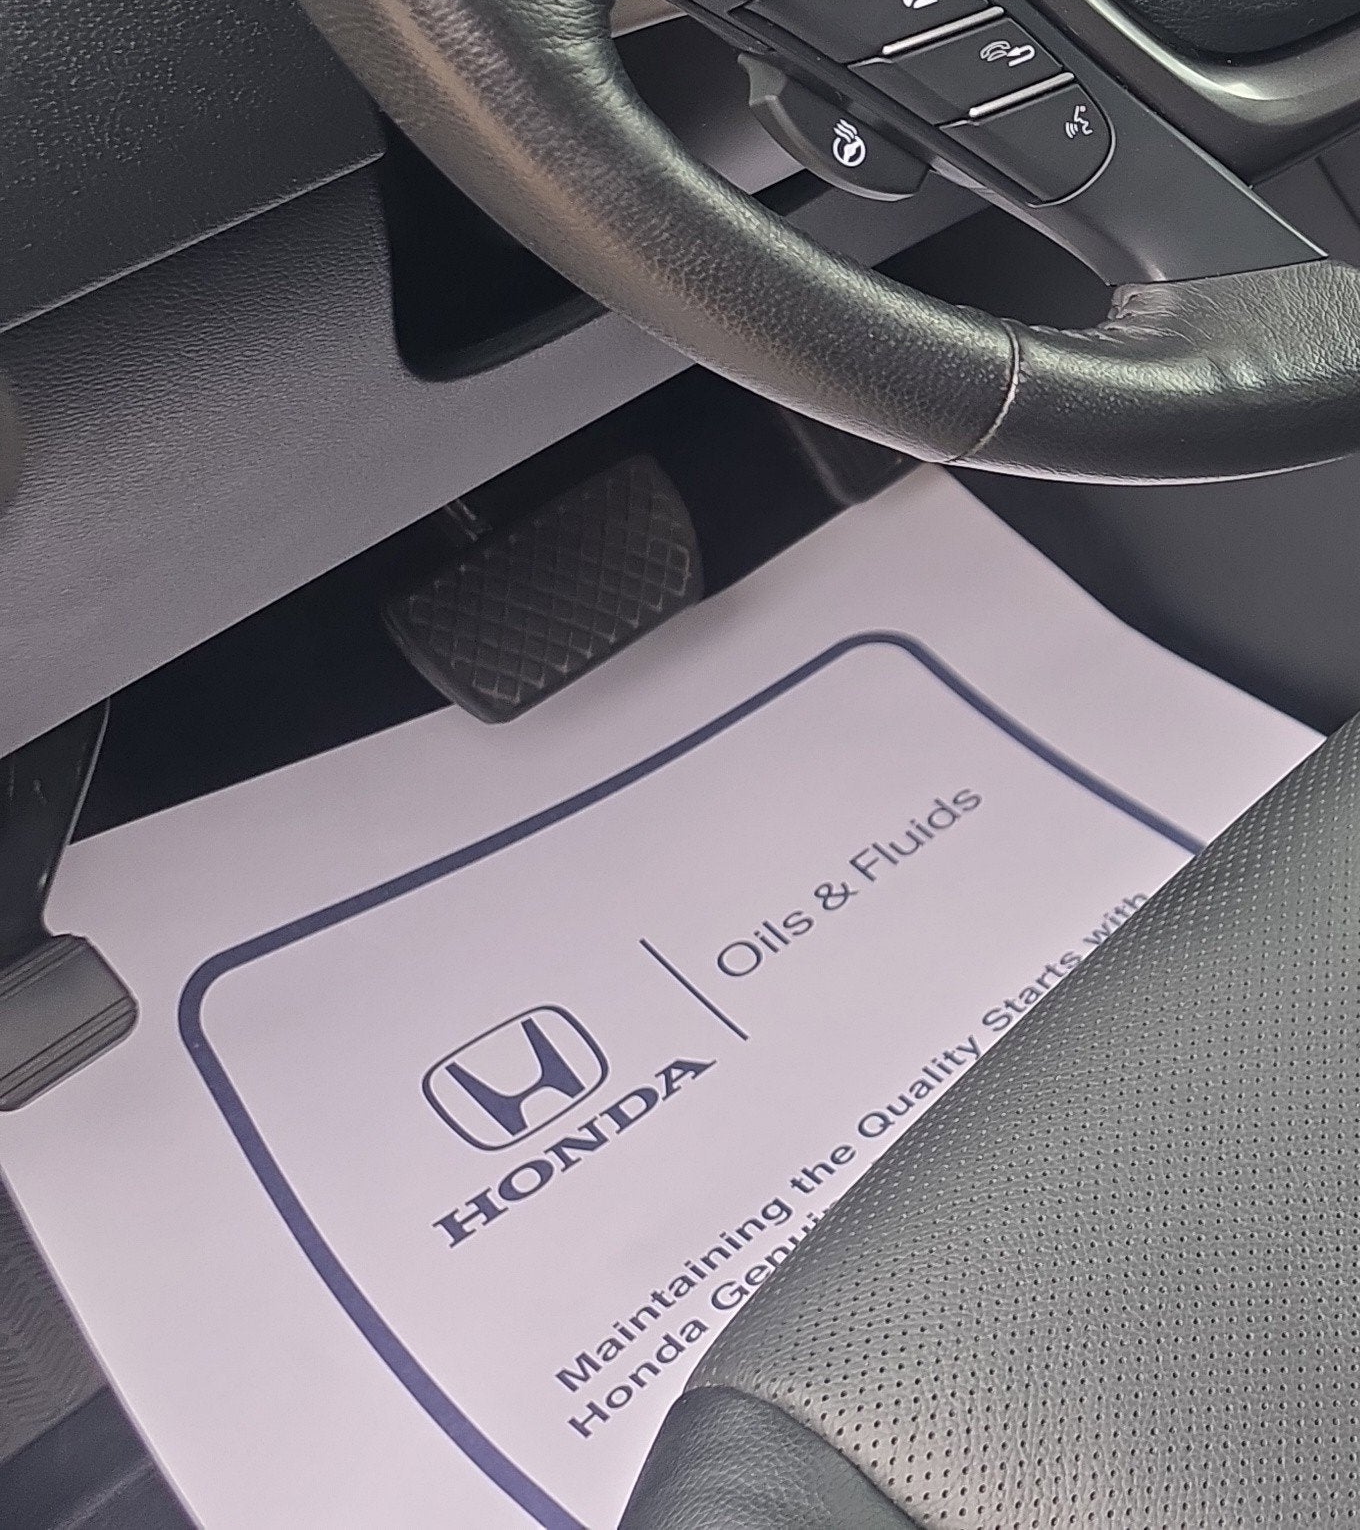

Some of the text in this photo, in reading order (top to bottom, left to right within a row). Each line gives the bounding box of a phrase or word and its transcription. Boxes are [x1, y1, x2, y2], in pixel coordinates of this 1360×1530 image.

[715, 785, 982, 979] Oils & Fluids
[432, 1055, 718, 1249] HONDA
[555, 1197, 794, 1394] Maintaining
[790, 1142, 857, 1194] the
[857, 1033, 982, 1141] Quality
[982, 950, 1083, 1033] Starts
[568, 1318, 709, 1438] Honda
